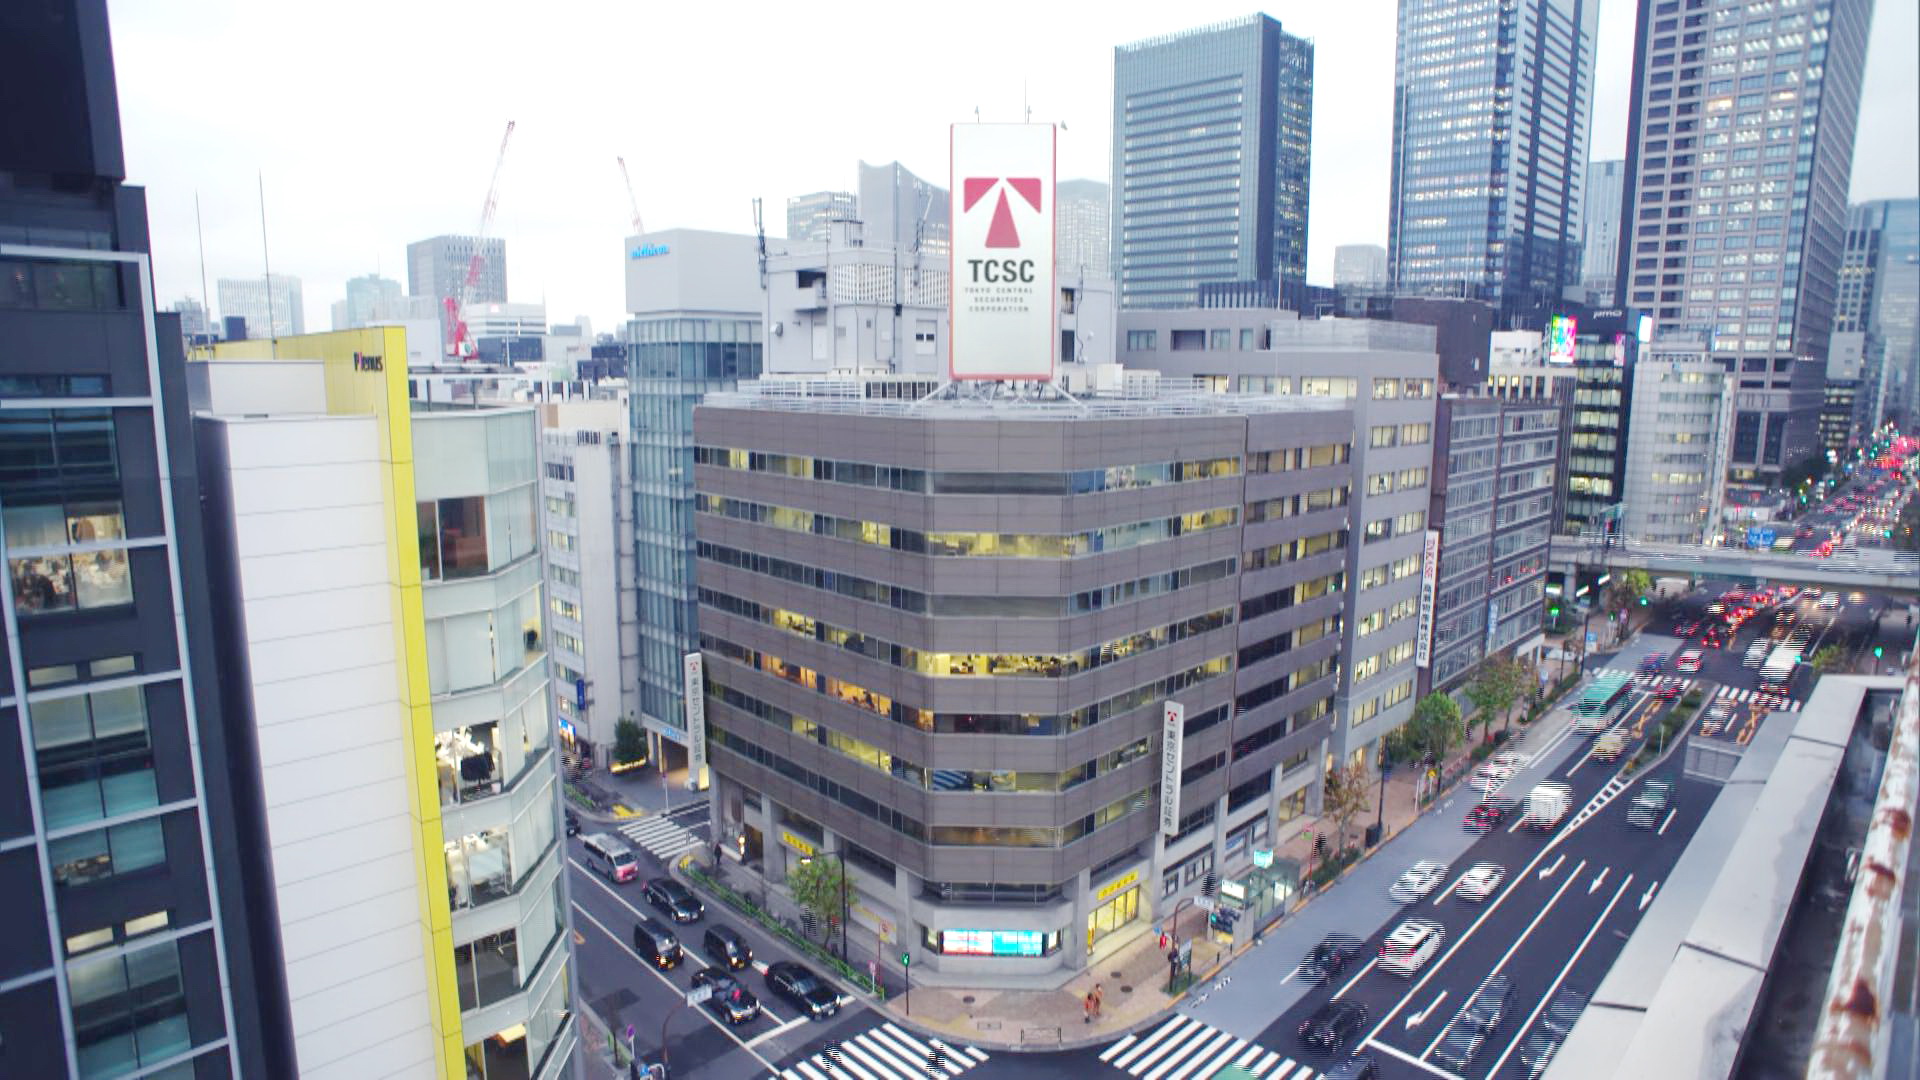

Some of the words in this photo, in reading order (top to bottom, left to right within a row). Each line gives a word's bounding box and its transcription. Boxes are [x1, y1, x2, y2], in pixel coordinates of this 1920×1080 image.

[967, 259, 1035, 283] TCSC
[353, 351, 384, 372] Plenus
[1163, 730, 1177, 828] 東京セントラル証券
